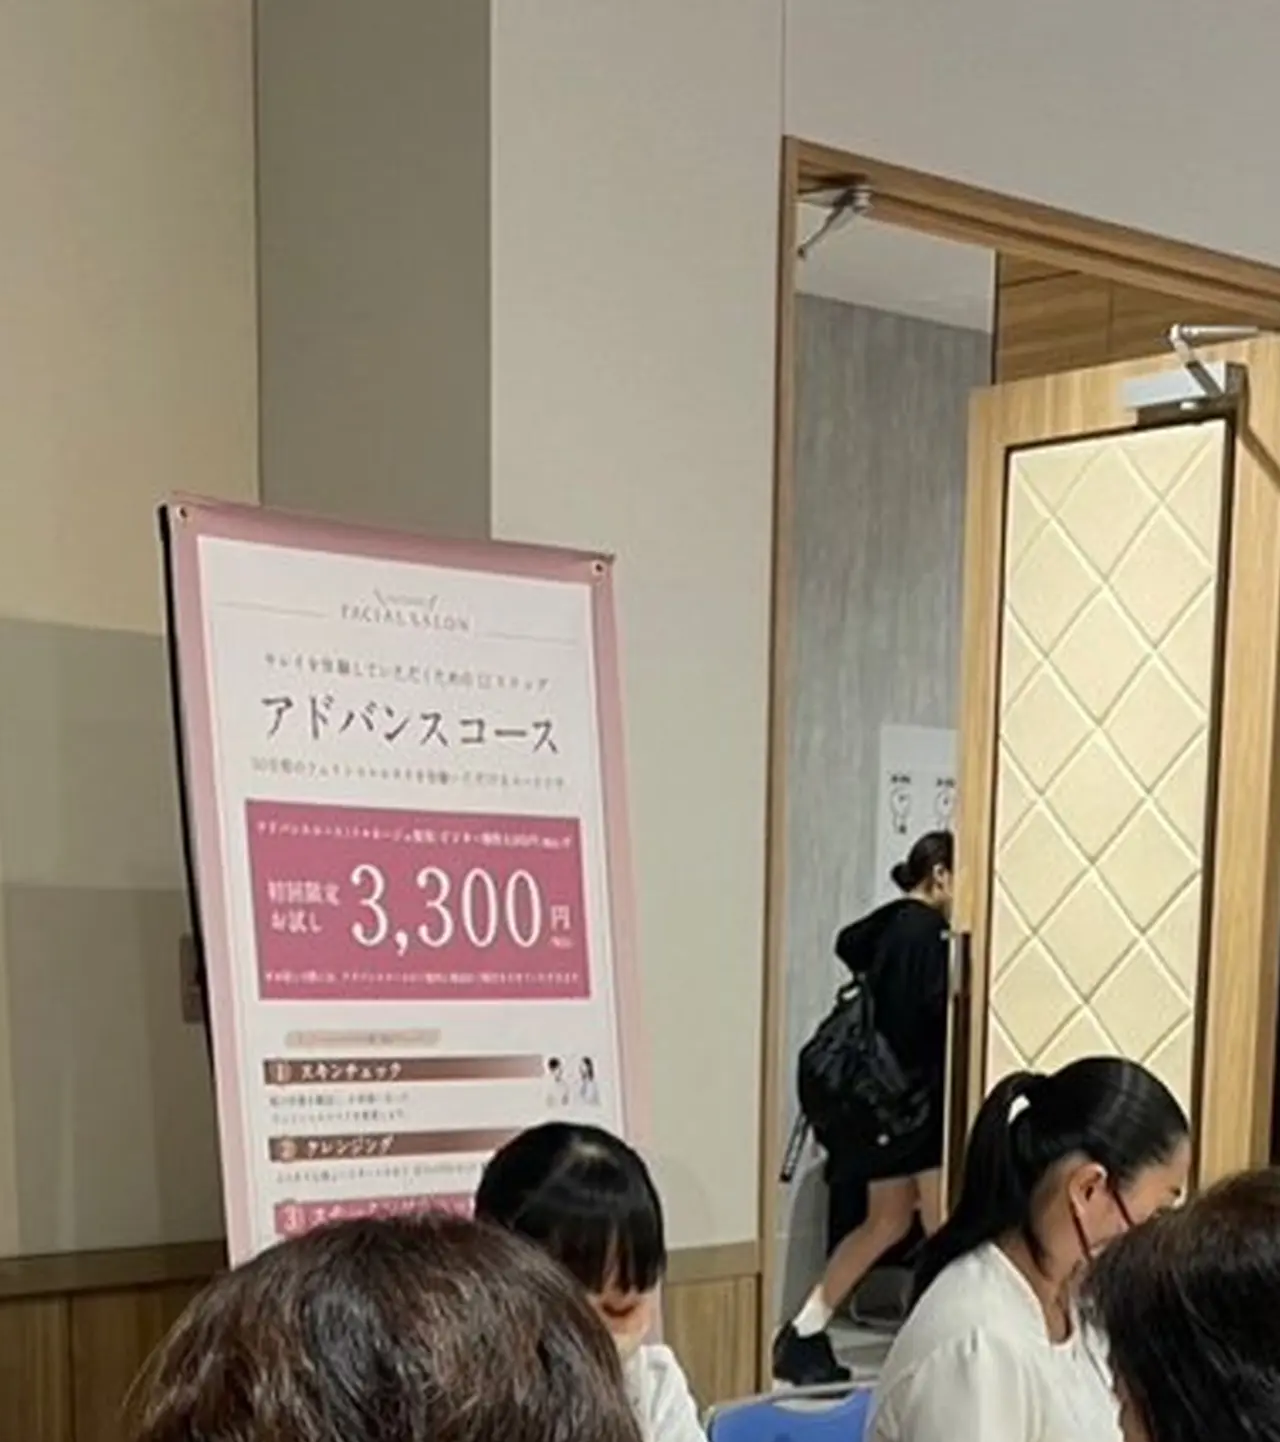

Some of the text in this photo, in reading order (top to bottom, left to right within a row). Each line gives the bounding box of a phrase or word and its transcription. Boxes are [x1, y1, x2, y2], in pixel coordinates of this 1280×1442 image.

[260, 695, 560, 755] アドバンスコース
[270, 909, 323, 934] お試し
[350, 863, 571, 957] 3,300 円
[301, 1061, 403, 1081] スキンチェック
